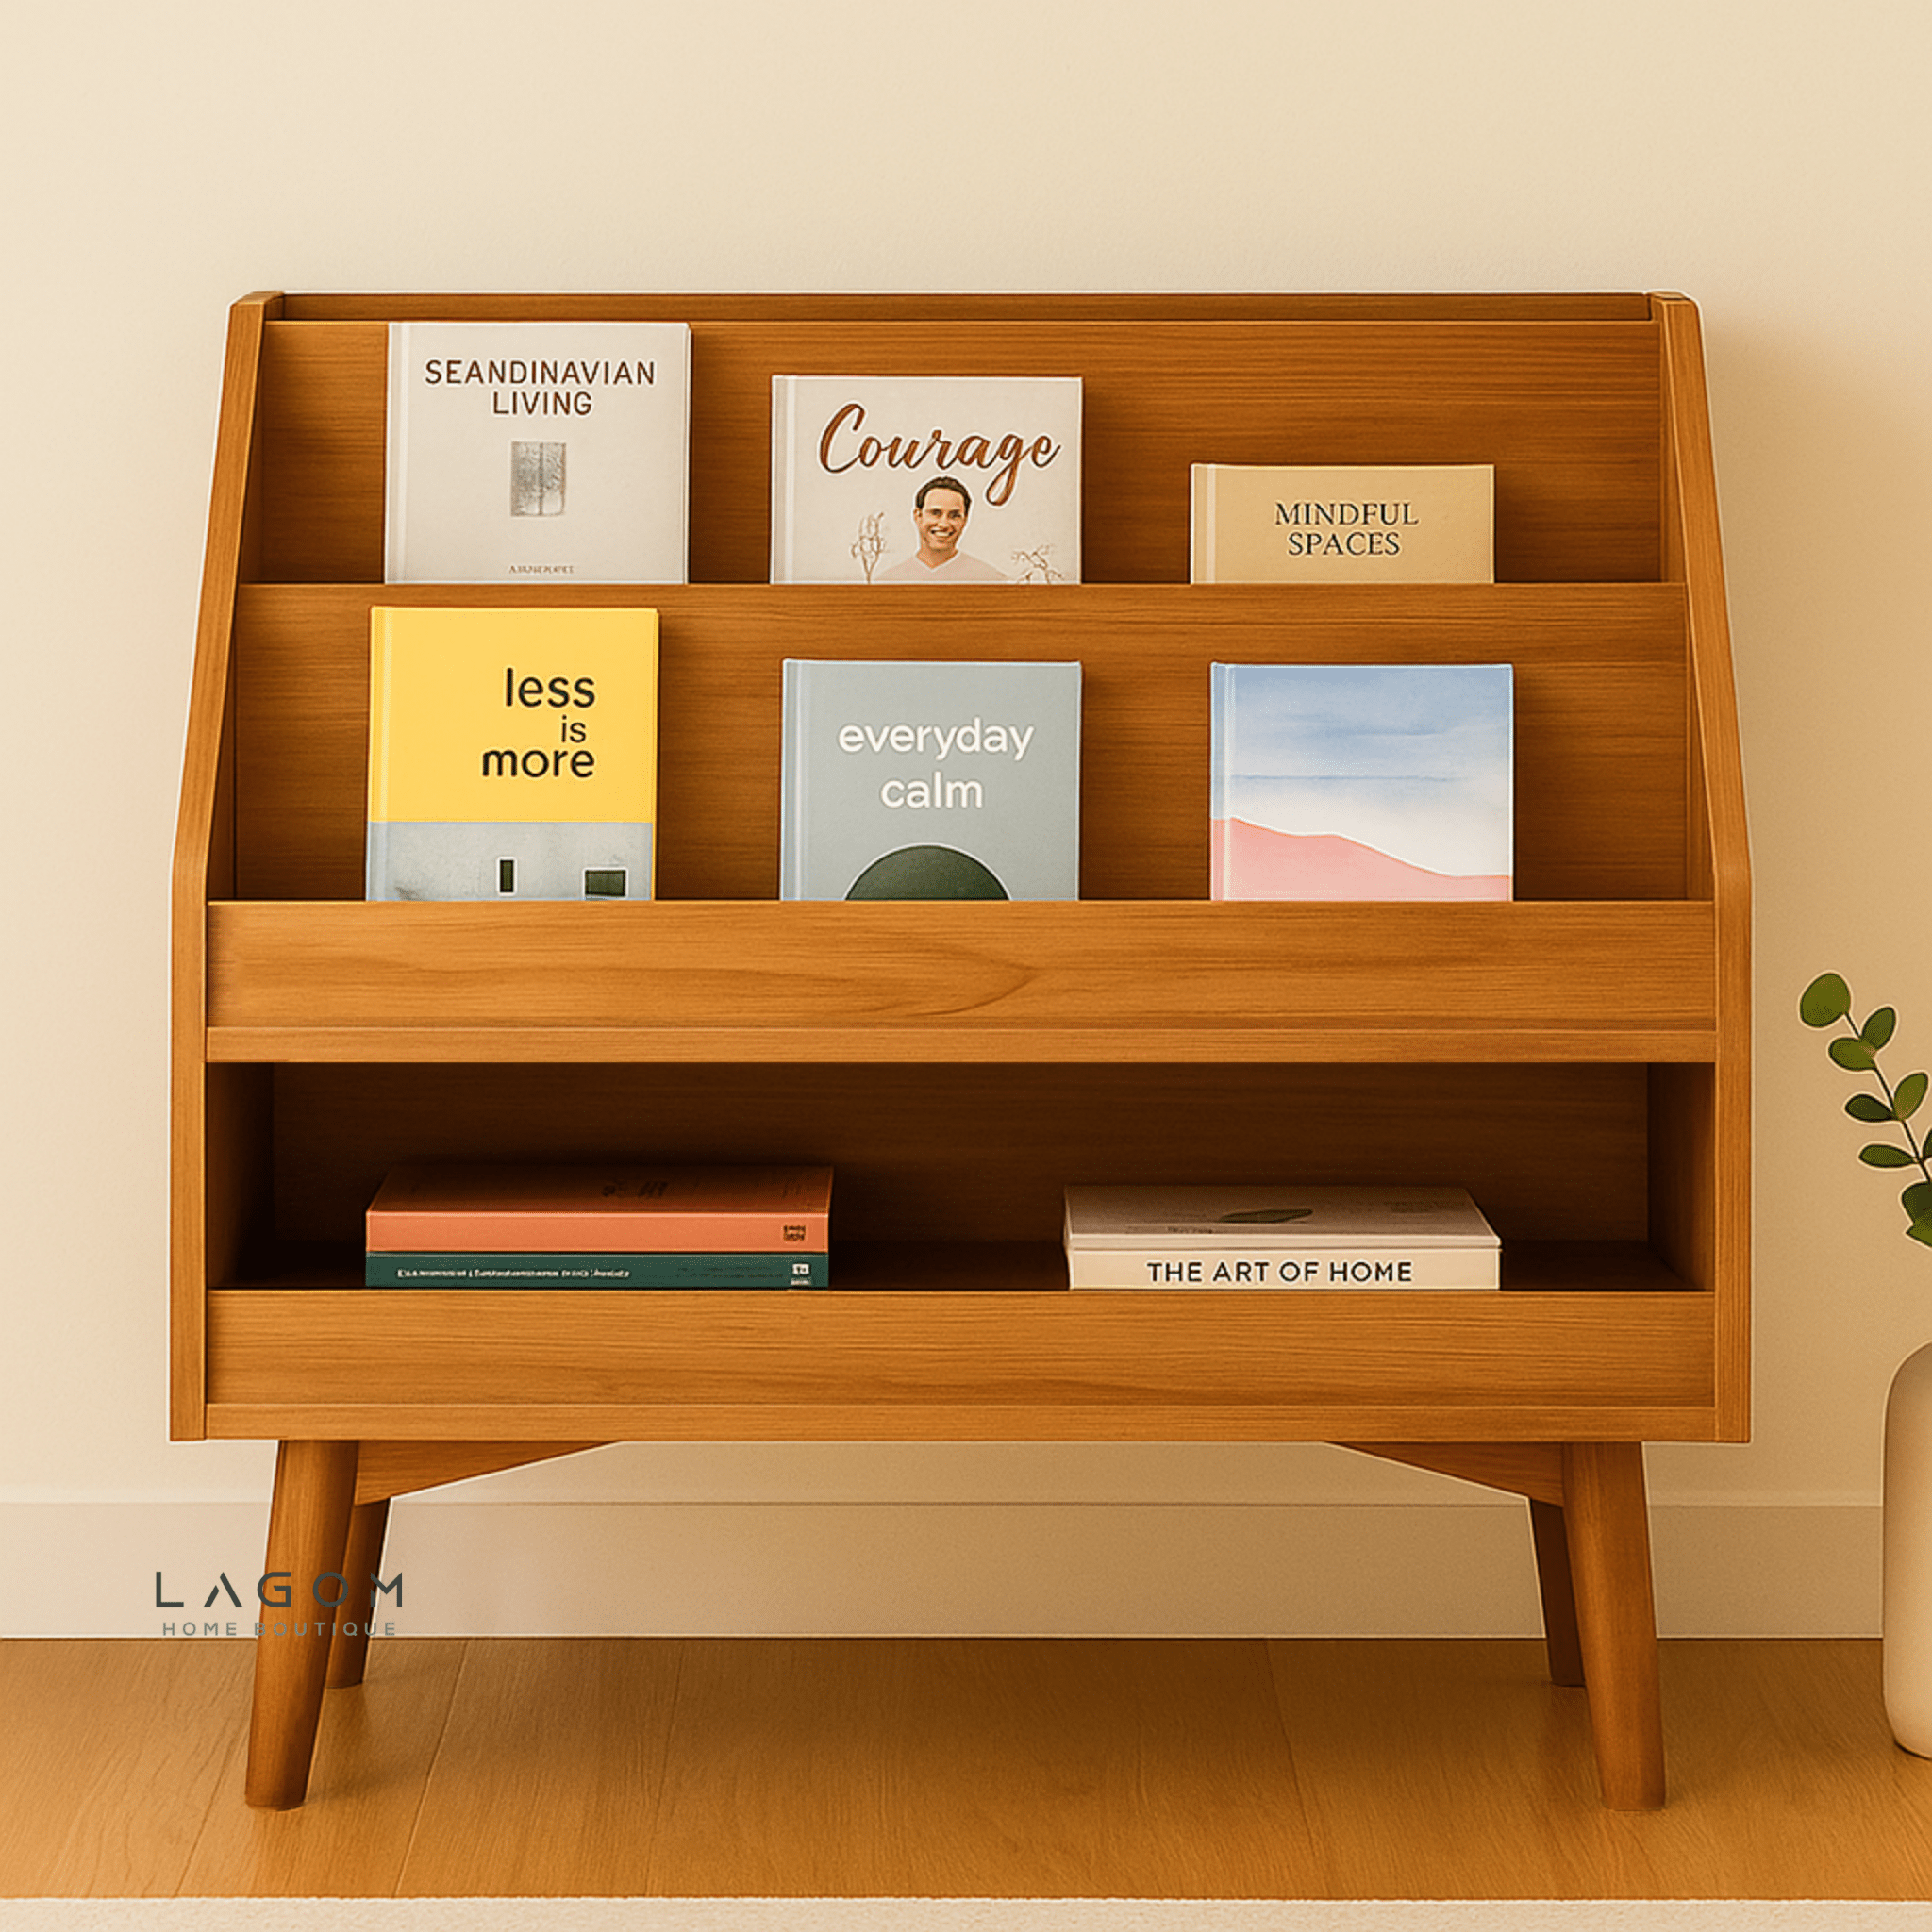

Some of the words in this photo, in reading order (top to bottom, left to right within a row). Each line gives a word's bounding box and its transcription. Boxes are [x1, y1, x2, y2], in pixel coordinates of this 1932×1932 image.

[425, 359, 656, 385] SEANDINAVIAN
[492, 391, 593, 416] LIVING
[819, 403, 1062, 507] Courage
[1274, 502, 1420, 526] MINDFUL
[1287, 532, 1401, 556] SPACES
[505, 667, 596, 708] less
[560, 714, 587, 743] is
[838, 715, 1035, 762] everyday
[482, 749, 595, 778] more
[880, 770, 984, 808] calm
[1147, 1261, 1203, 1283] THE
[1212, 1261, 1270, 1283] ART
[1278, 1261, 1320, 1283] OF
[1329, 1261, 1414, 1283] HOME
